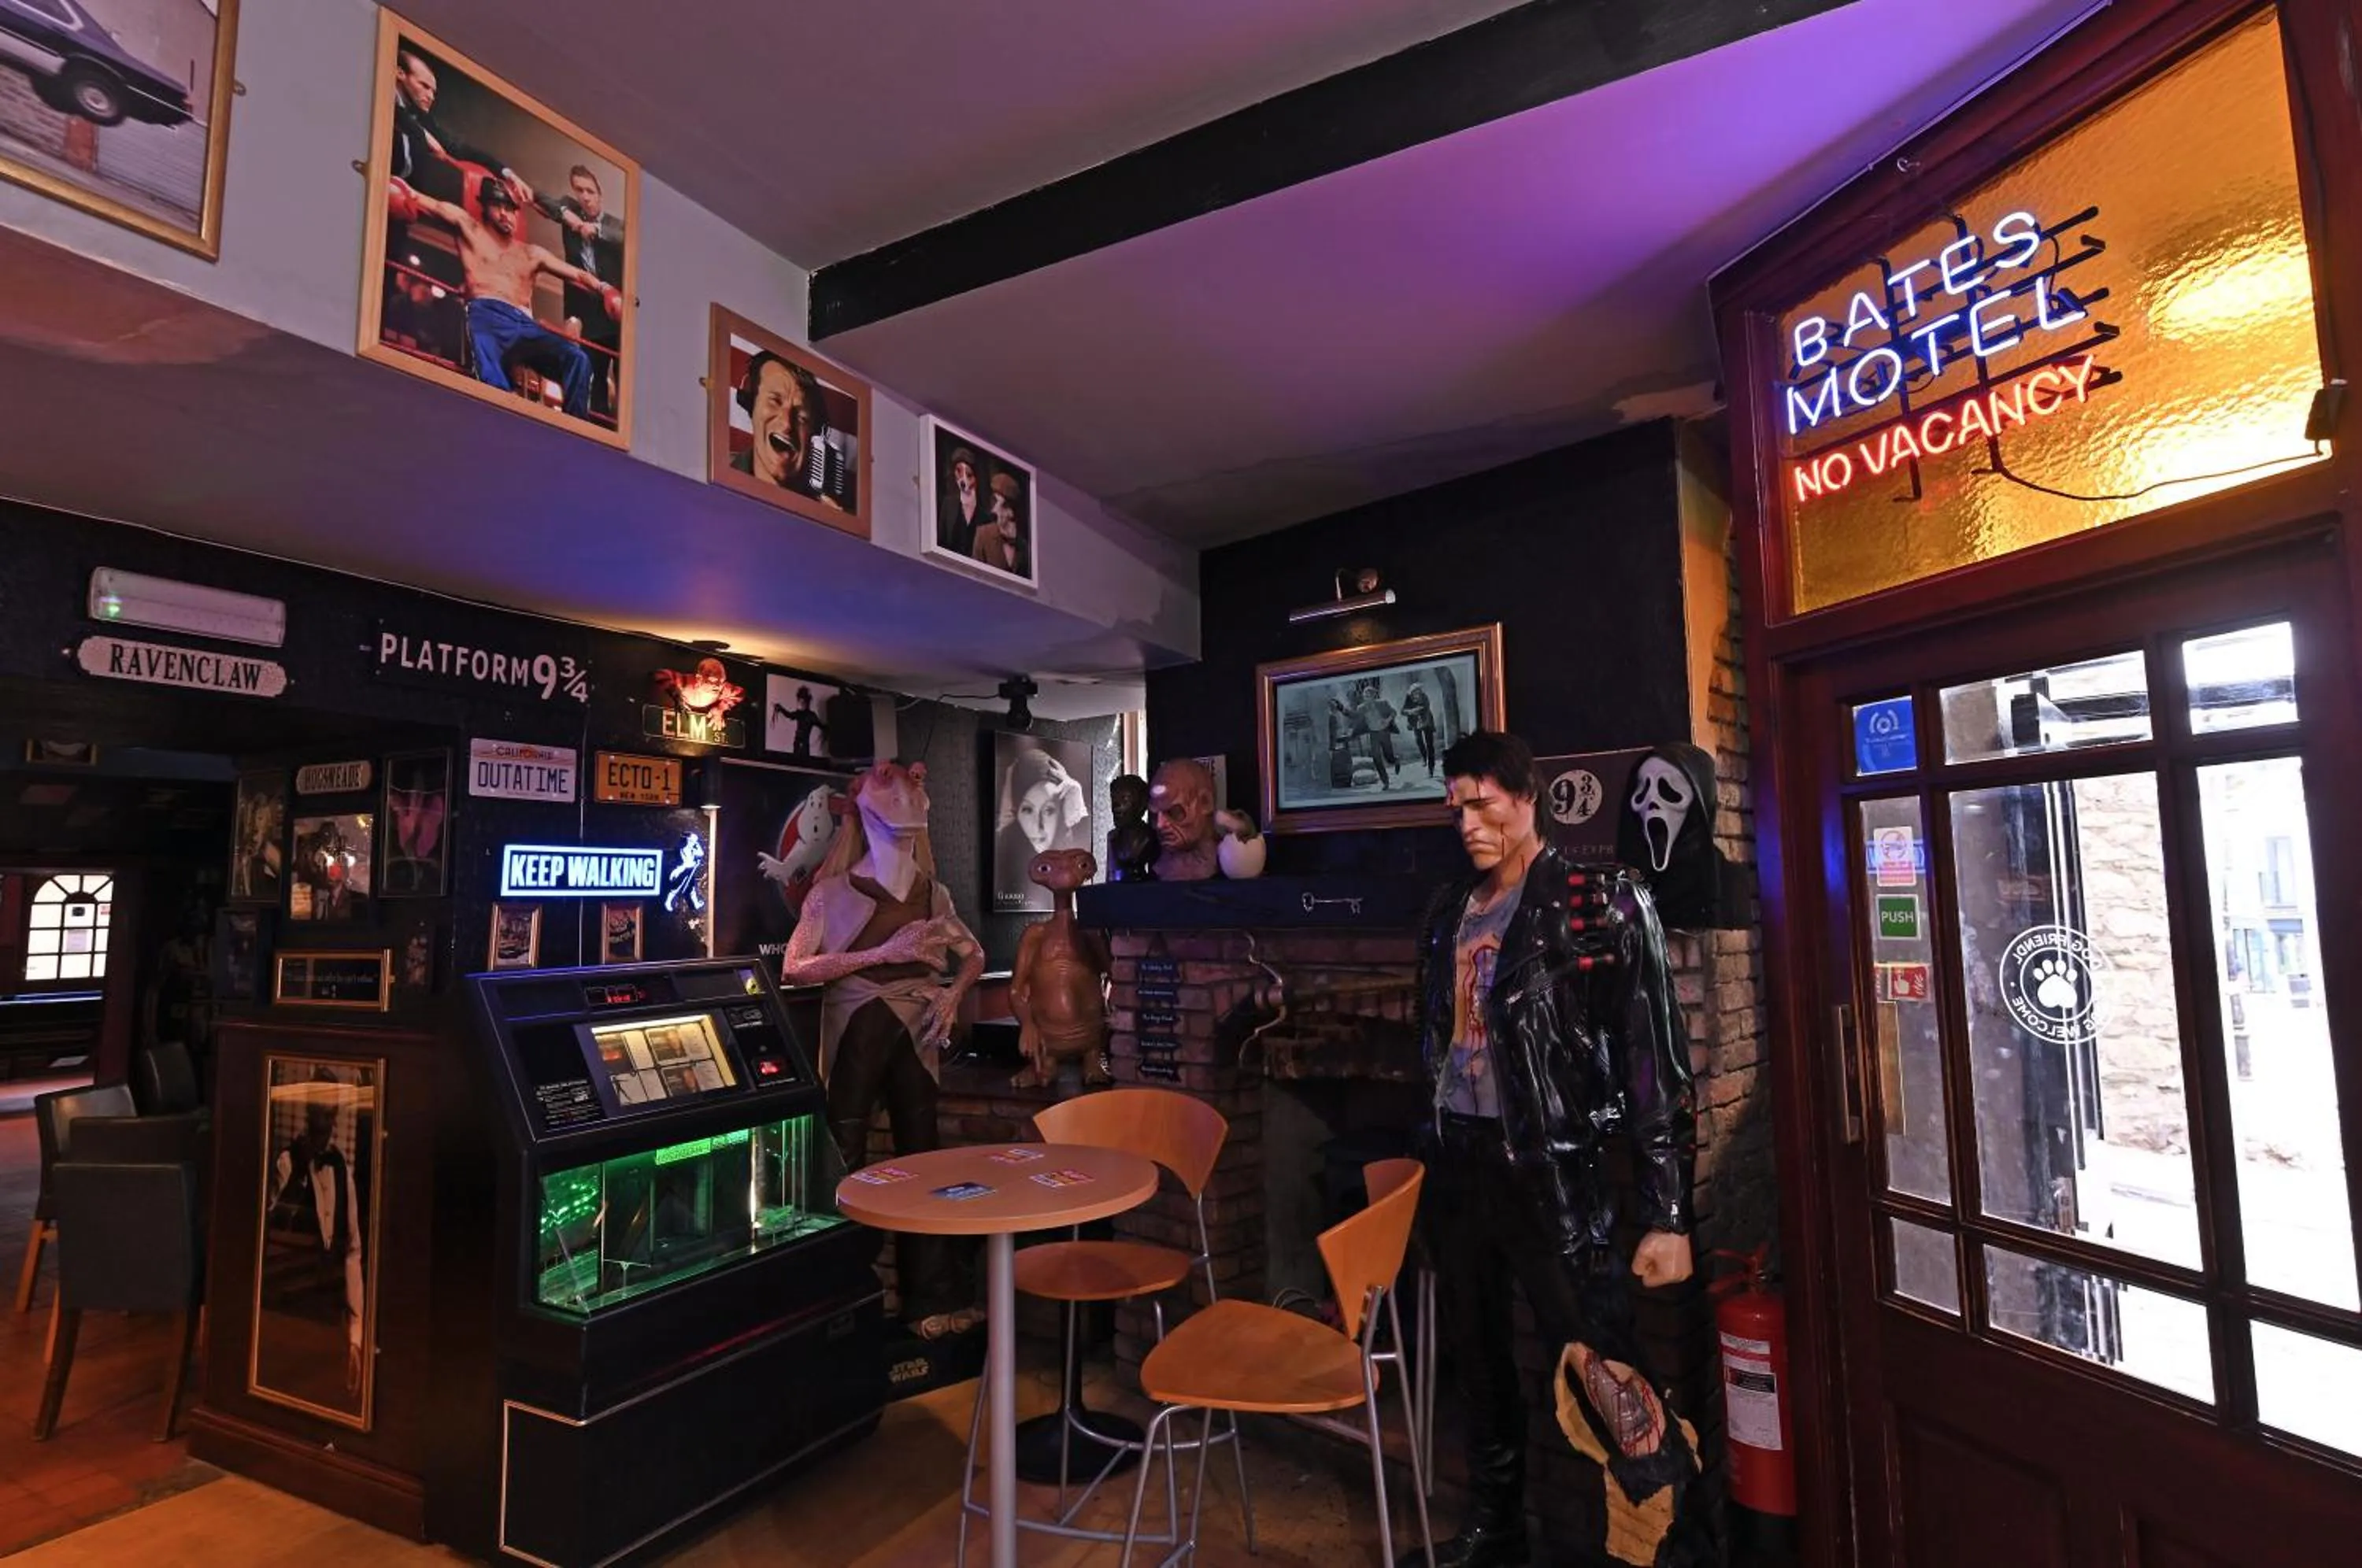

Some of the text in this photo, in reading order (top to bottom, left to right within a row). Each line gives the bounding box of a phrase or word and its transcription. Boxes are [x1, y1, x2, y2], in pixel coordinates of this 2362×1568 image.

[1794, 212, 2040, 368] BATES
[1785, 275, 2087, 436] MOTEL
[1793, 354, 2094, 502] NO VACANCY
[109, 643, 261, 690] RAVENCLAW
[380, 632, 529, 688] PLATFORM
[662, 709, 707, 741] ELM
[477, 761, 569, 794] OUTATIME
[607, 762, 670, 791] ECTO-1
[511, 854, 655, 888] KEEP WALKING
[1880, 911, 1915, 923] PUSH
